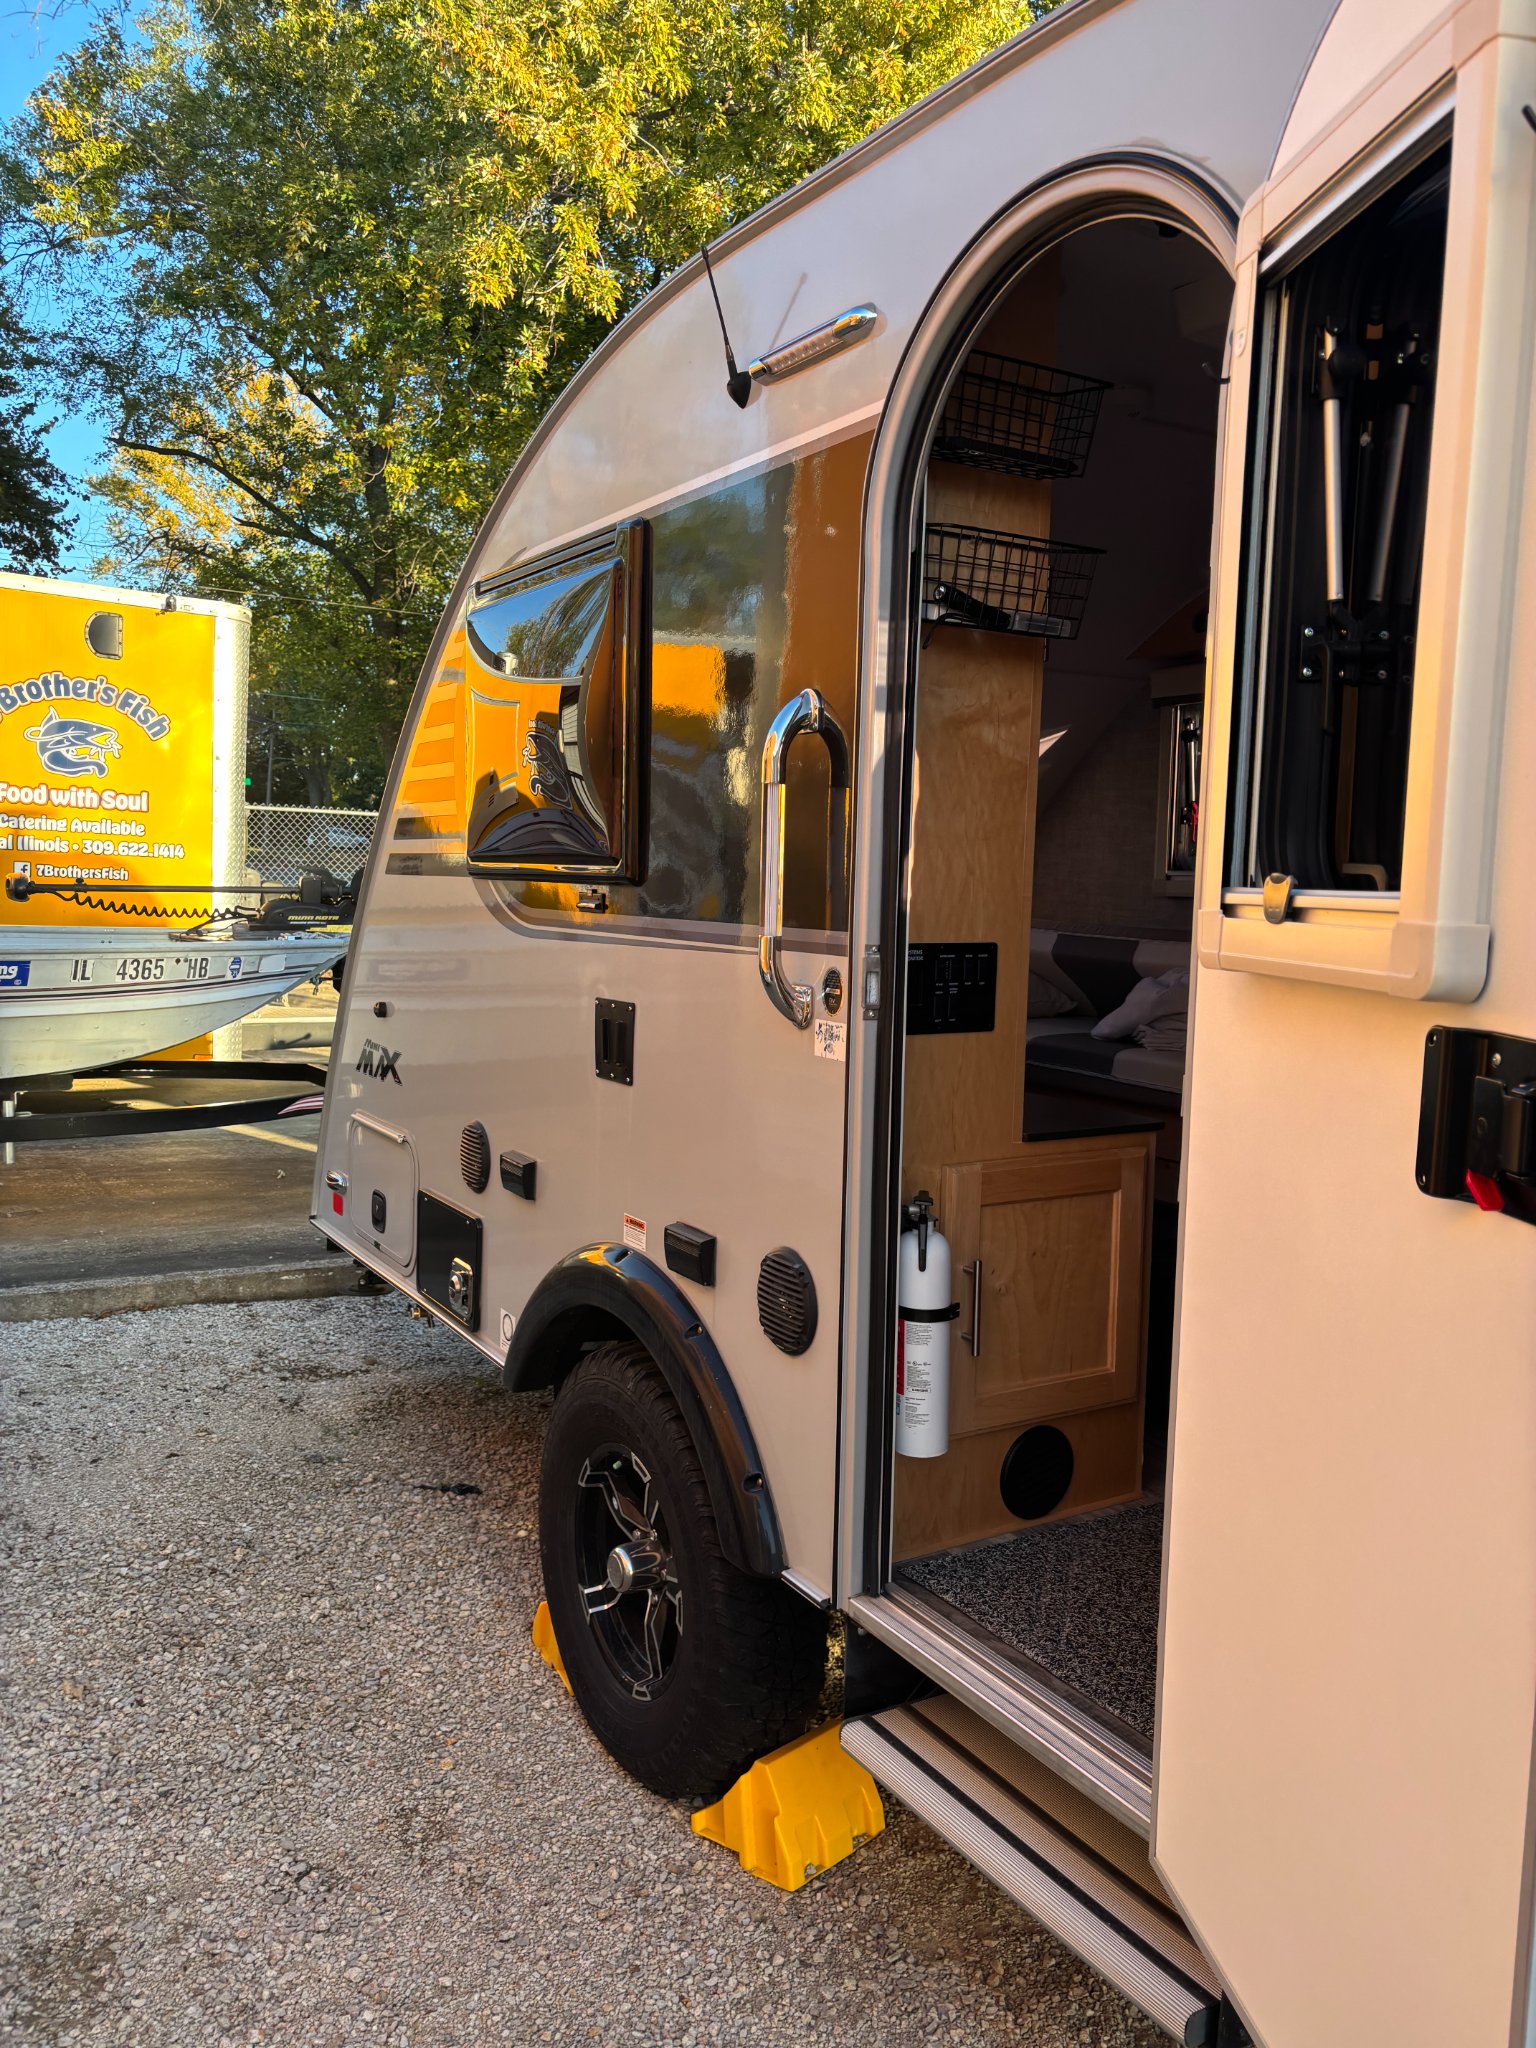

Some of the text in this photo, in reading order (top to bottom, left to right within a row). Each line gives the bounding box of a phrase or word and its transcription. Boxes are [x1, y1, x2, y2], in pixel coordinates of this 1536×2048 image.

[0, 671, 171, 741] Brother's Fish
[0, 782, 149, 812] Food with Soul
[0, 813, 145, 836] Catering Available
[82, 839, 185, 859] 309.622.1414
[36, 864, 129, 880] 7BrothersFish
[72, 957, 209, 981] IL 4365 HB
[356, 1046, 403, 1086] MAX
